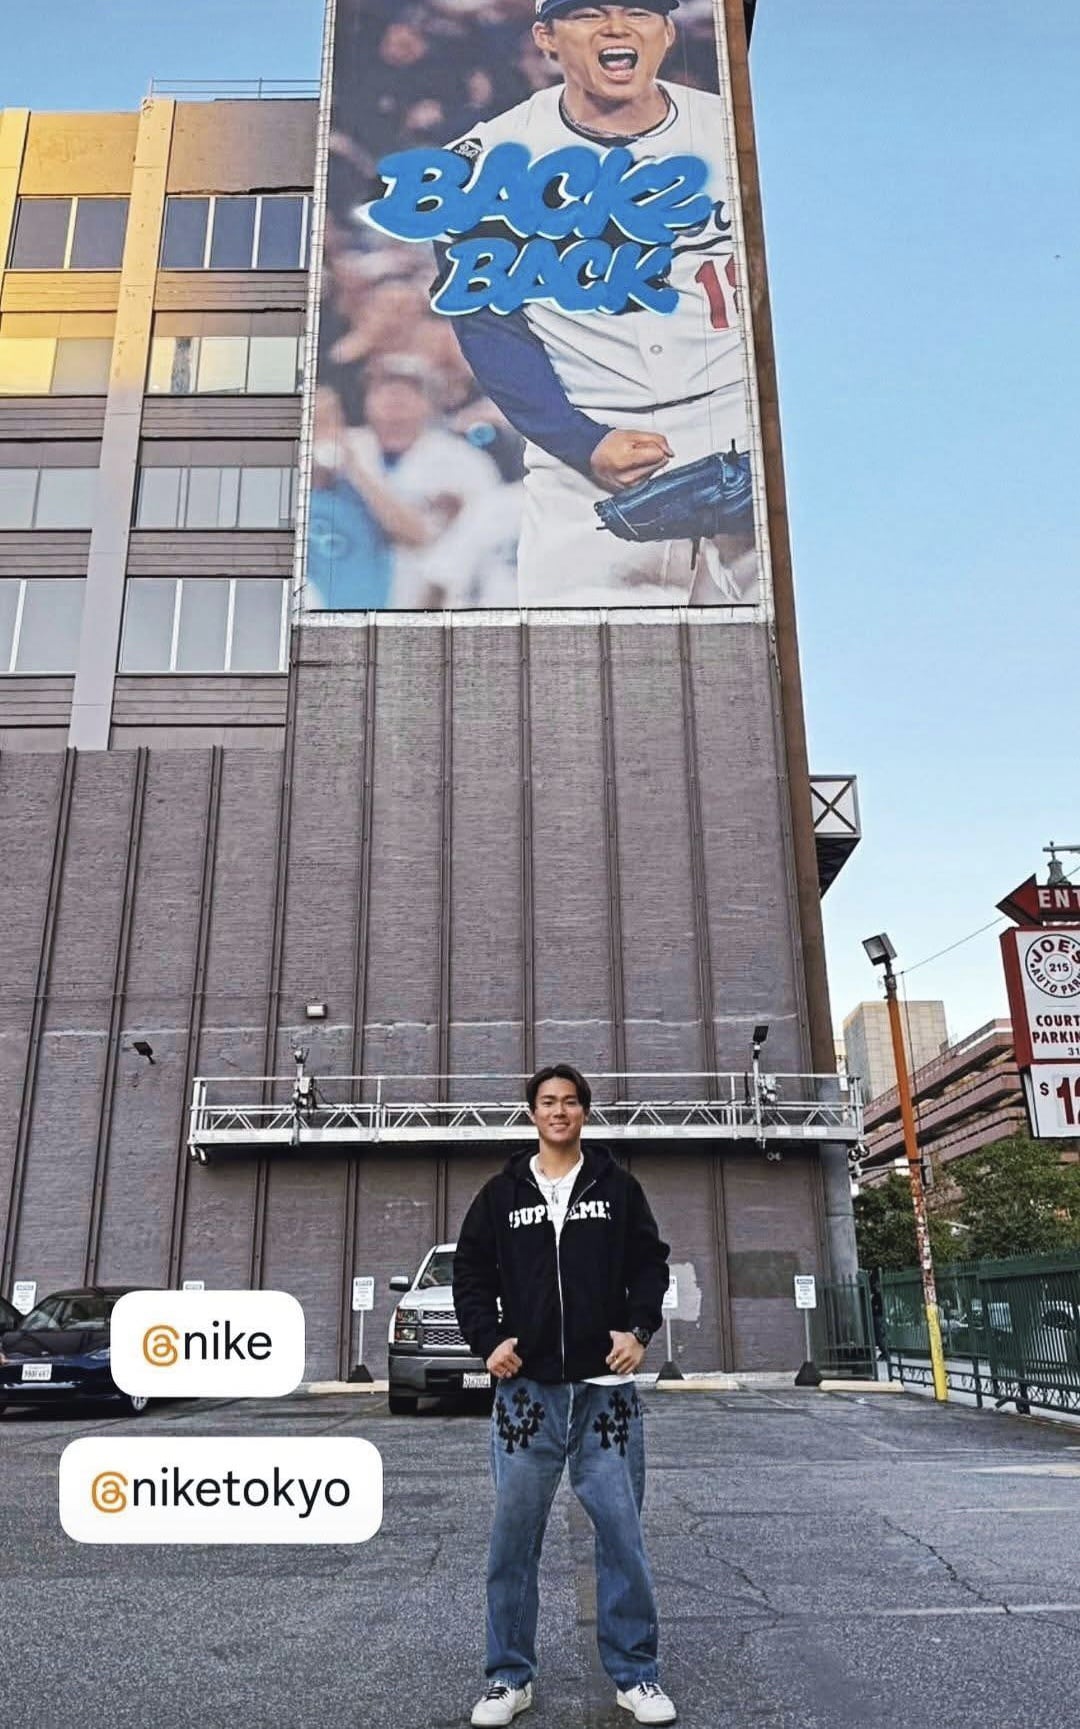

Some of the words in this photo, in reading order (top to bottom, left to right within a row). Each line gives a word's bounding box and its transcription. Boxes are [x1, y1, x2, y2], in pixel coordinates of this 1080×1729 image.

[430, 236, 679, 315] BACK
[1049, 963, 1069, 972] 215
[1031, 969, 1057, 993] AUTO
[1040, 1082, 1049, 1096] $
